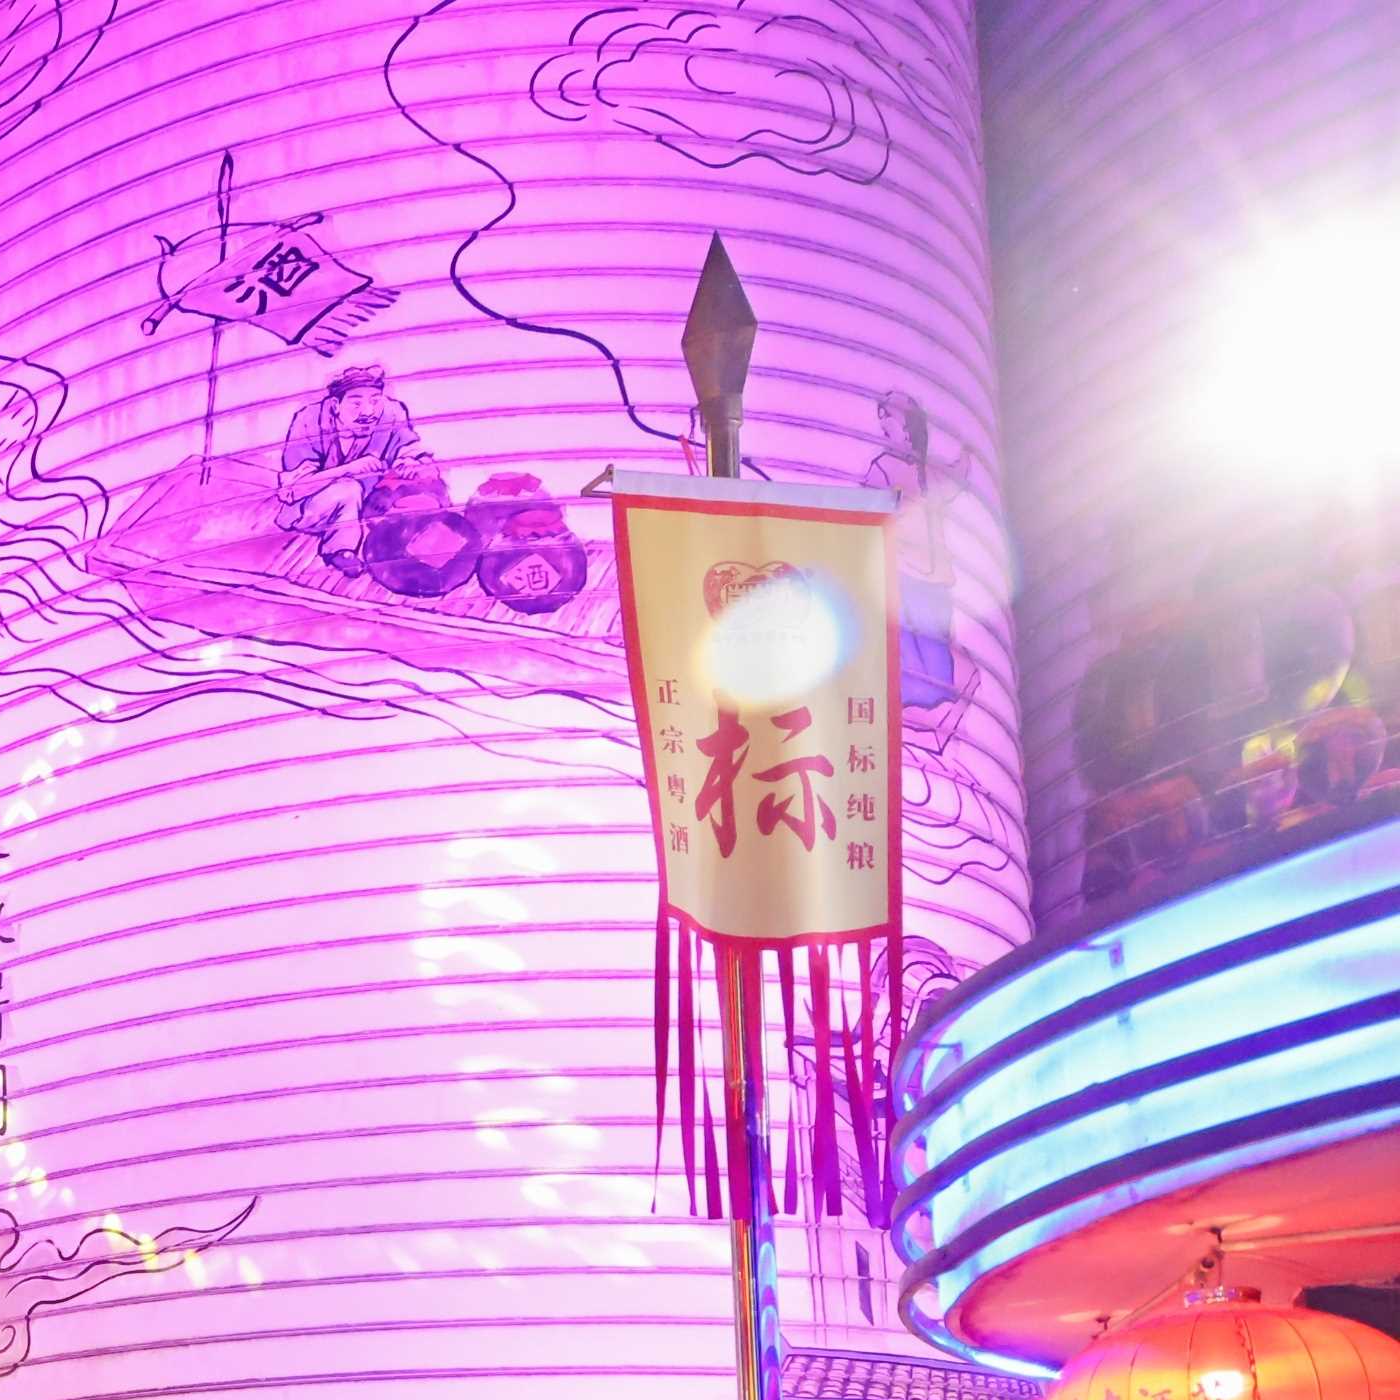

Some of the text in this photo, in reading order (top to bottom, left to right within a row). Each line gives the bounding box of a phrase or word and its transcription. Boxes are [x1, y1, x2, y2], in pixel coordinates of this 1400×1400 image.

[223, 242, 320, 315] 酒
[514, 563, 549, 592] 酒
[657, 678, 690, 856] 正宗粤酒
[694, 692, 837, 859] 标
[846, 696, 877, 871] 国标纯粮
